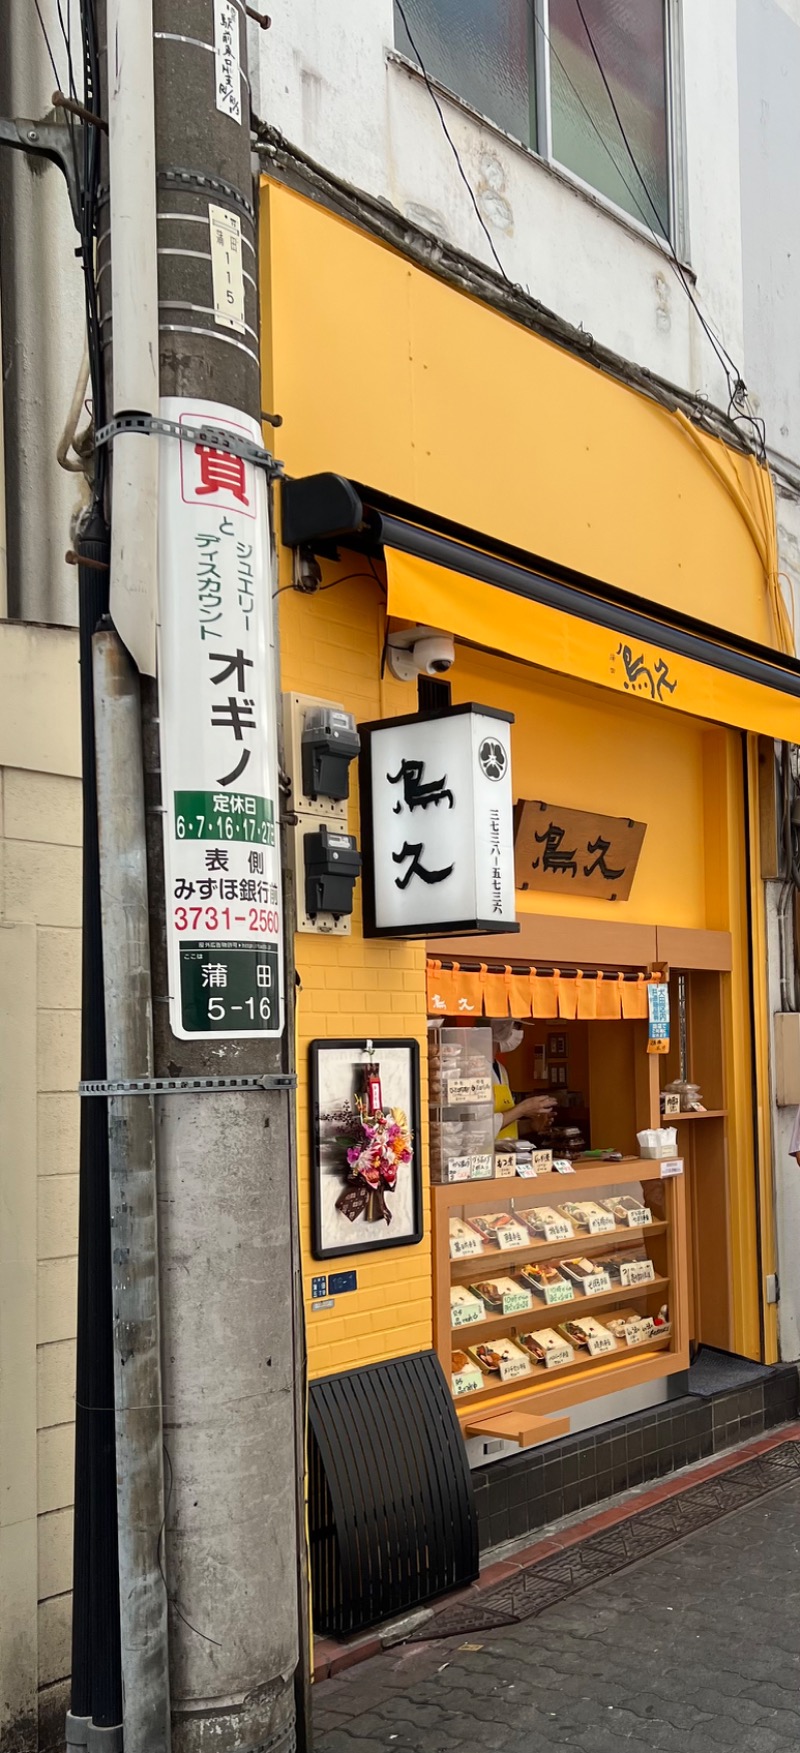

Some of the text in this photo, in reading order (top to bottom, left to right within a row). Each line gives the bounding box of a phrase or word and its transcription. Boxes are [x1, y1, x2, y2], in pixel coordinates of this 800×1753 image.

[225, 251, 235, 304] 115
[215, 516, 235, 537] と
[195, 533, 223, 641] ディスカウント
[236, 542, 254, 631] ジュエリー
[209, 648, 257, 787] オギノ
[213, 794, 257, 815] 定休日
[386, 758, 454, 890] 鳥久
[174, 877, 278, 906] みずほ銀行前
[174, 906, 279, 934] 3731-2560
[207, 997, 271, 1021] 5-16
